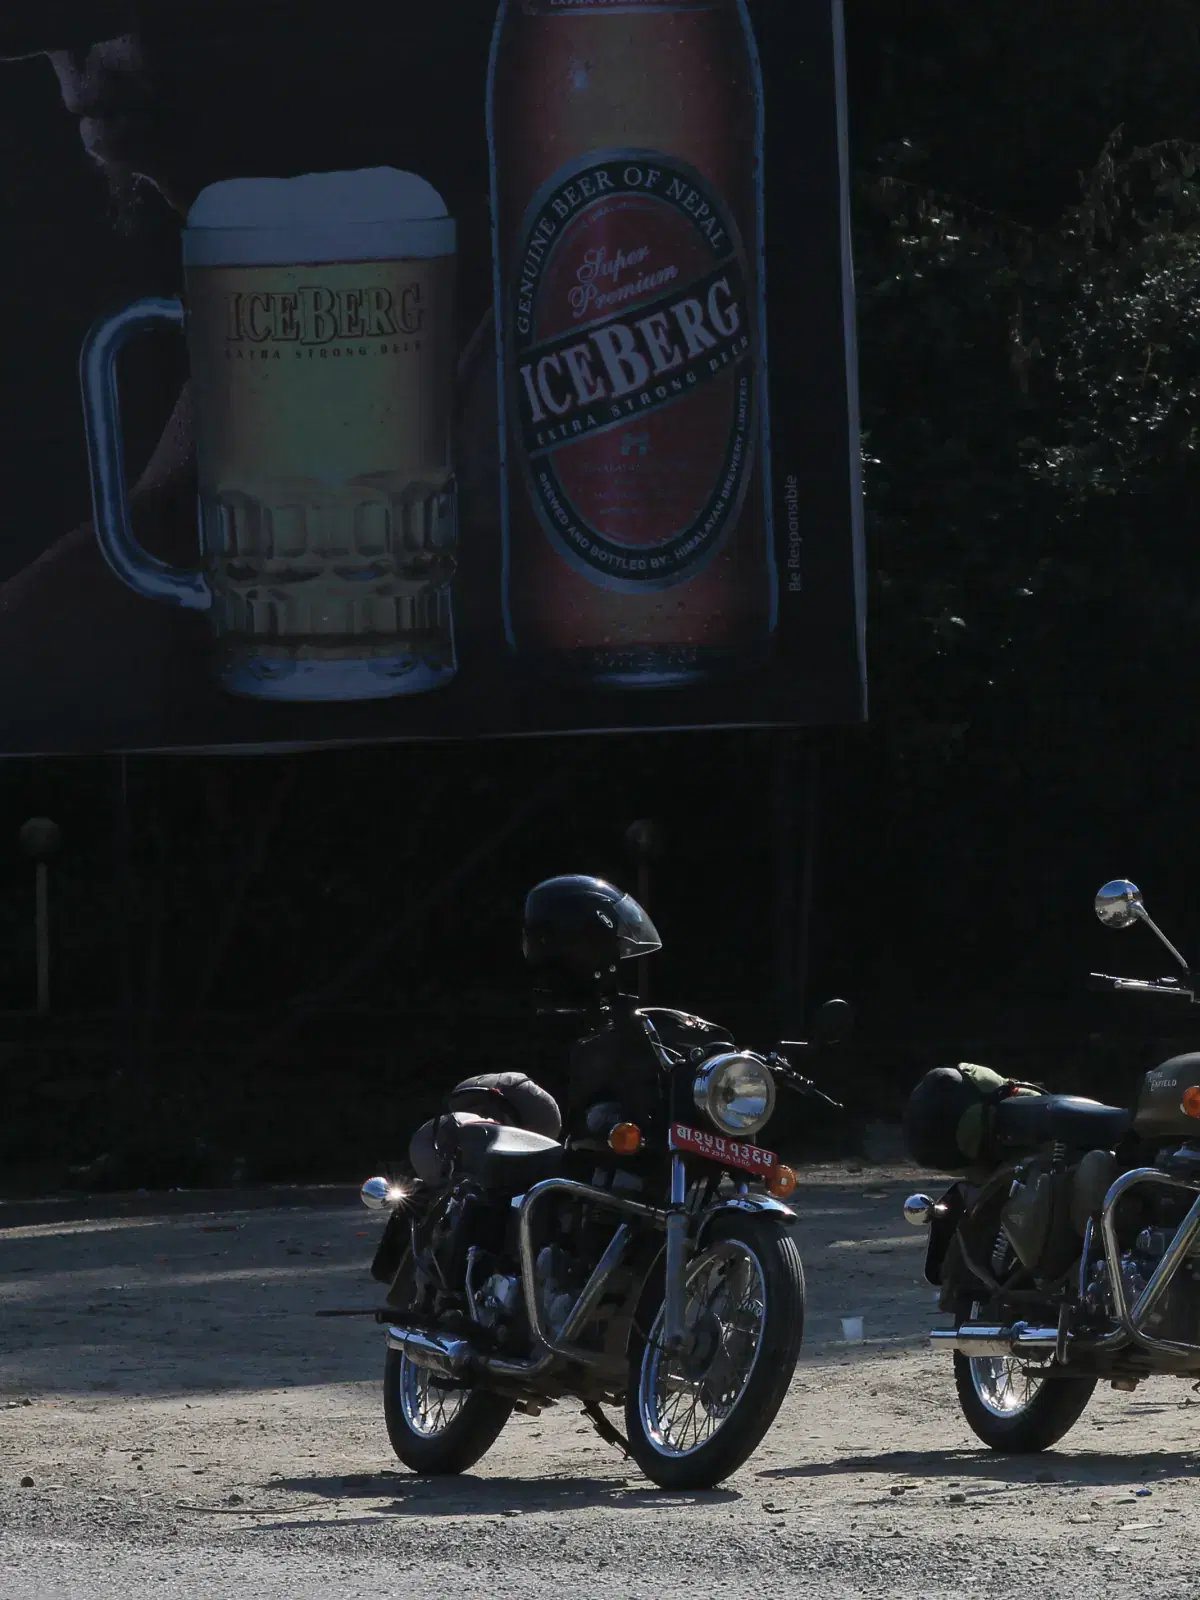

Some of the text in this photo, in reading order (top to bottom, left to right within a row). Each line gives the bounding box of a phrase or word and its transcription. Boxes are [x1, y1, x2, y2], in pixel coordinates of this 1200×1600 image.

[516, 217, 557, 335] GENUINE
[551, 169, 616, 219] BEER
[623, 166, 661, 189] OF
[665, 177, 727, 249] NEPAL
[576, 245, 650, 283] Super
[226, 283, 425, 345] ICEBERG
[567, 264, 680, 319] Premium
[295, 346, 368, 360] STRONG
[519, 276, 740, 424] ICEBERG
[536, 413, 599, 446] EXTRA
[610, 371, 697, 417] STRONG
[539, 472, 569, 525] BREWED
[567, 525, 591, 550] AND
[589, 544, 647, 571] BOTTLED
[673, 500, 726, 560] HIMALAYAN
[720, 433, 744, 500] BREWERY
[737, 376, 749, 432] LIMITED
[784, 474, 803, 592] Be Responsible
